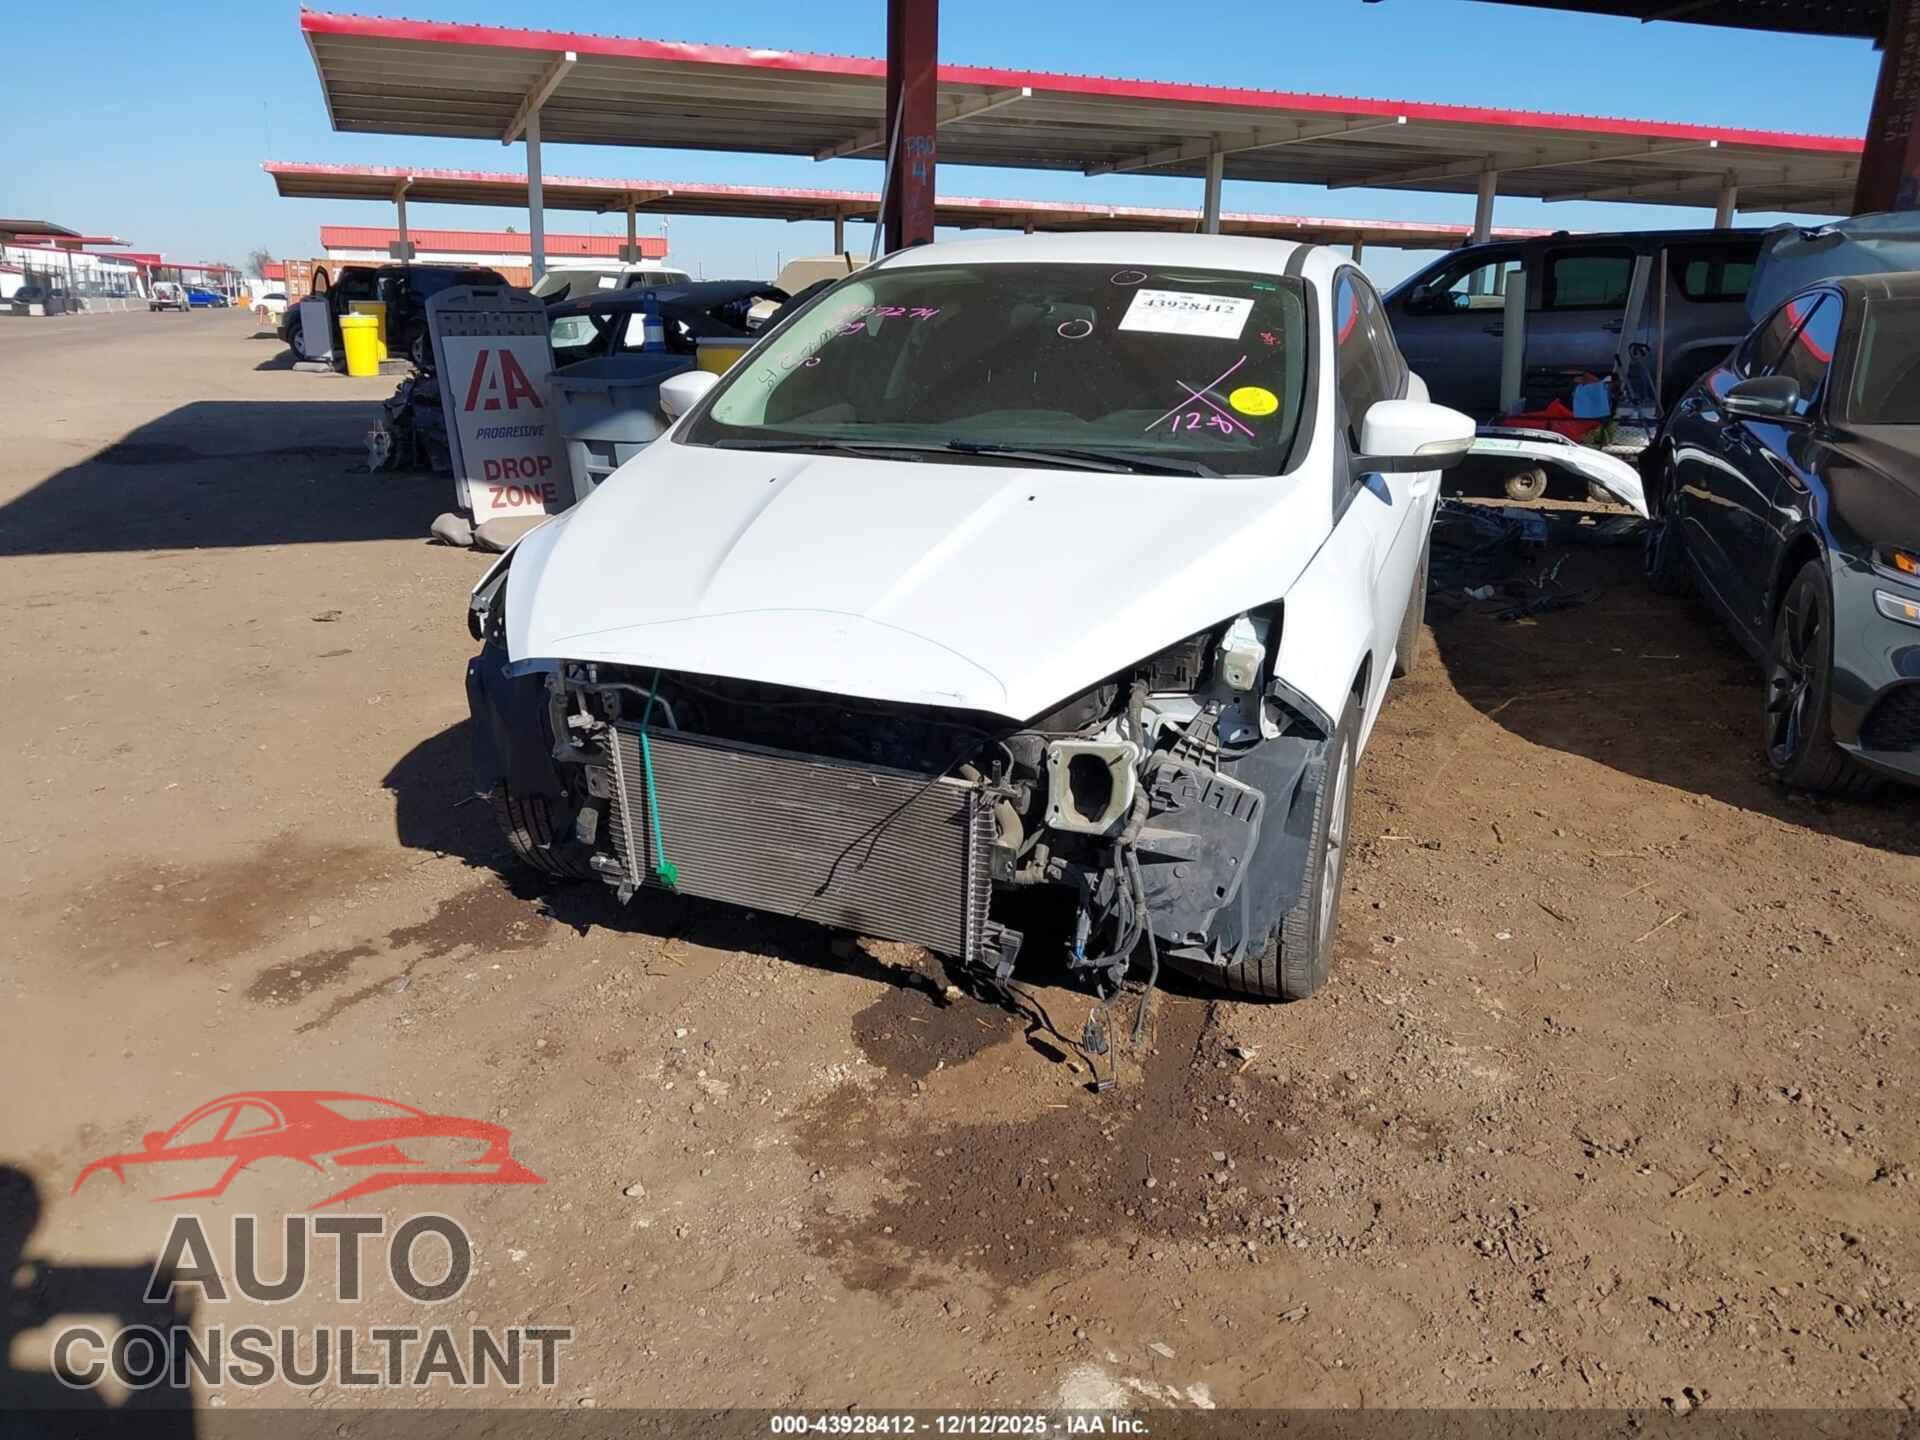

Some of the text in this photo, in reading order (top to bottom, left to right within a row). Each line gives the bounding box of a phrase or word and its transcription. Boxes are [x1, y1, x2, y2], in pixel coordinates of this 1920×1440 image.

[1143, 298, 1236, 315] 43928412
[476, 424, 545, 440] PROGRESSIVE
[483, 456, 553, 481] DROP
[489, 482, 558, 509] ZONE
